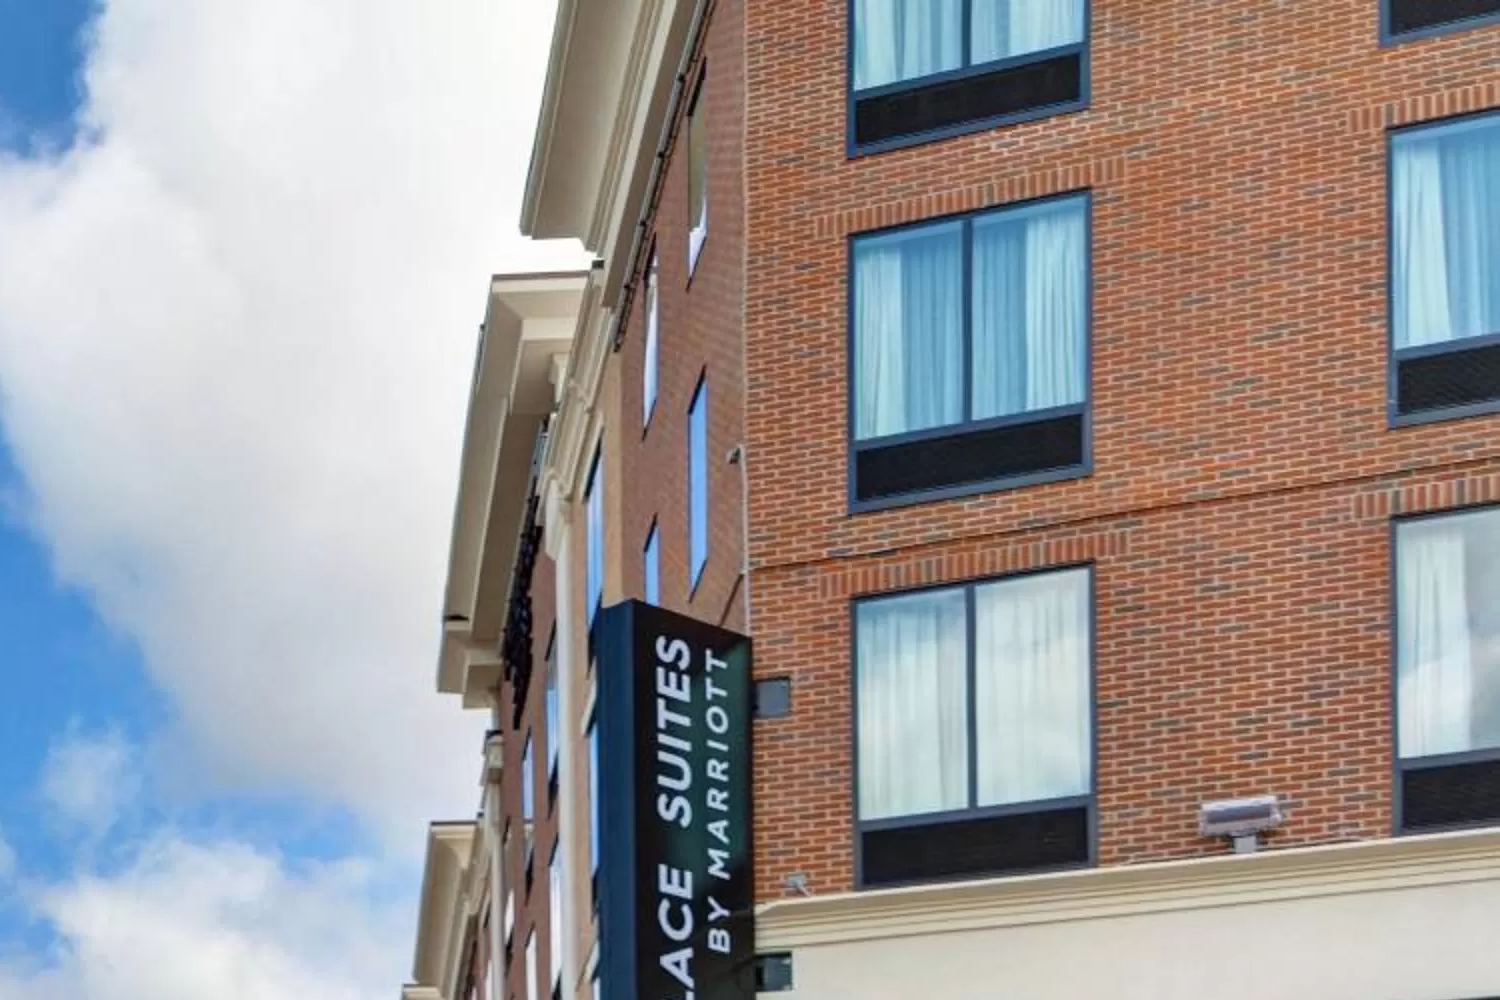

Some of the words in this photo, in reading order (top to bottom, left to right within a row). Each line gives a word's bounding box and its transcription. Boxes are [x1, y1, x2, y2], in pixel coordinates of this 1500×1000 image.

[655, 635, 693, 829] SUITES
[705, 647, 731, 880] MARRIOTT
[707, 895, 731, 954] BY
